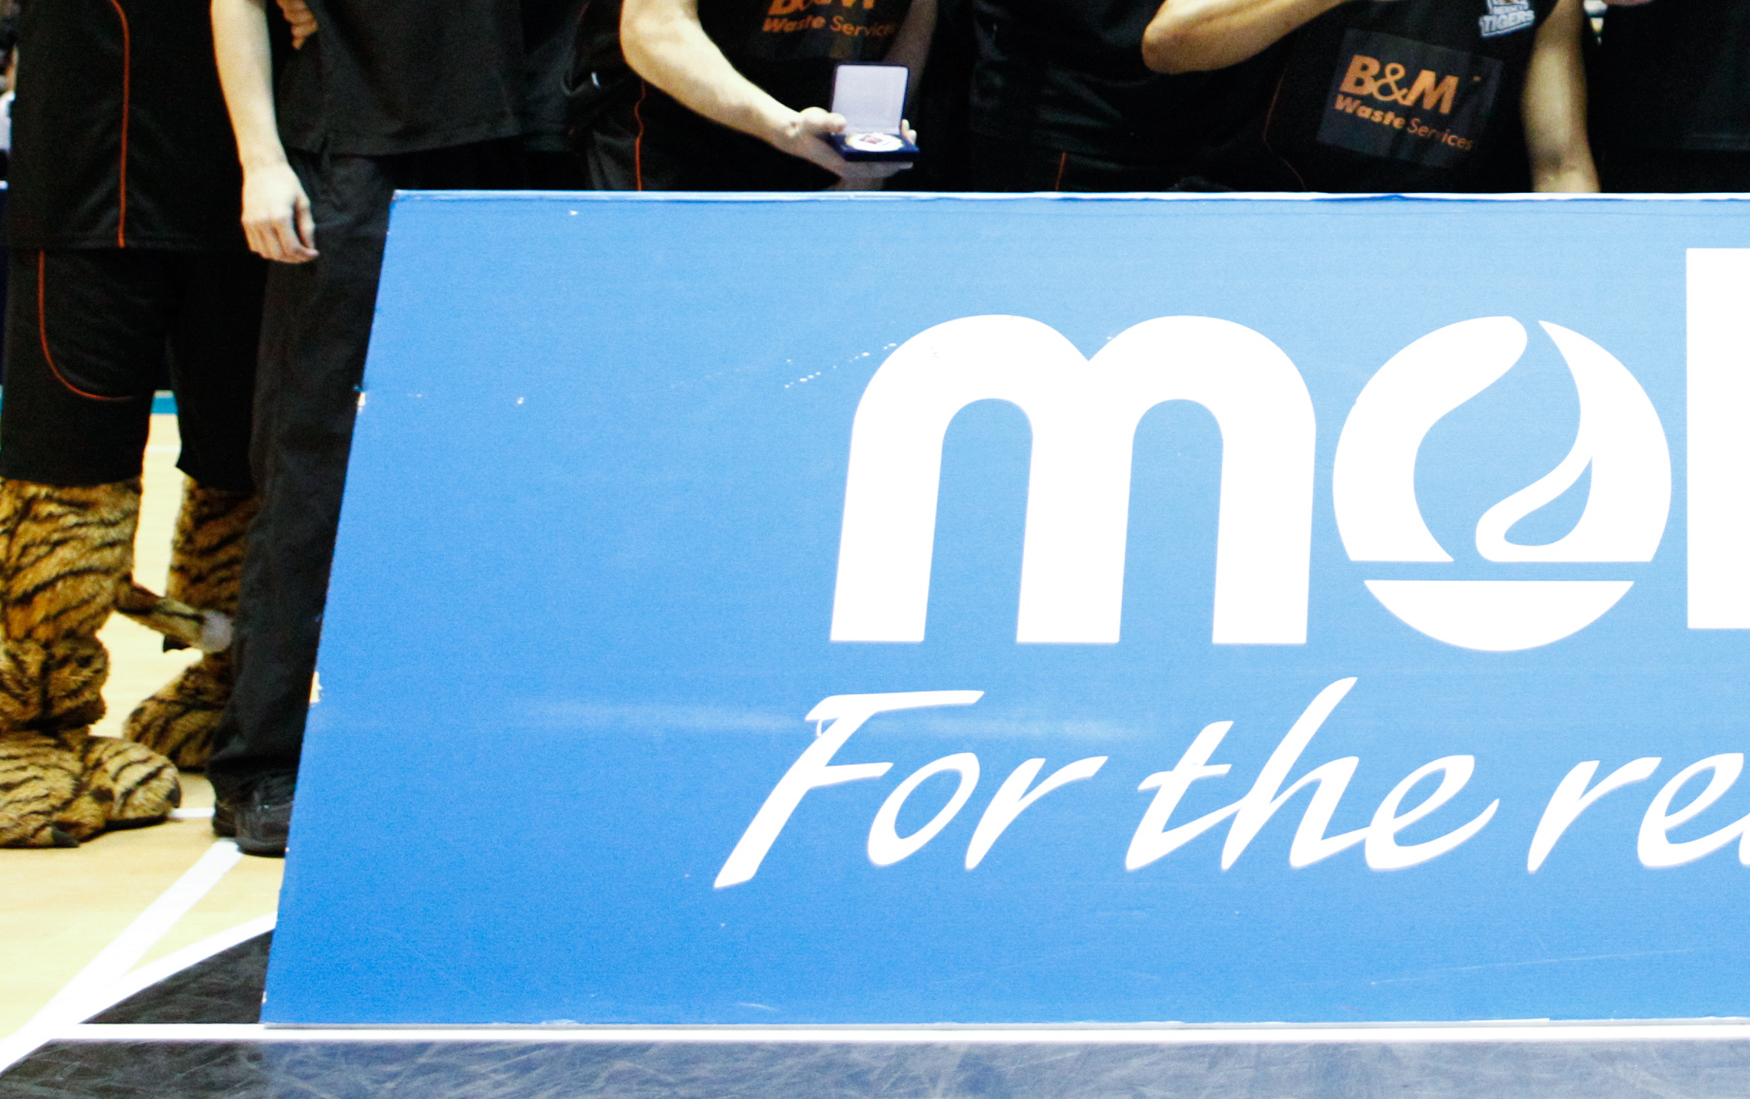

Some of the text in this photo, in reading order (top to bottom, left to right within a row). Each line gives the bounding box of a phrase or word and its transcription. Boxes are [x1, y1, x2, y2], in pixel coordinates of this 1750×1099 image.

[1481, 10, 1535, 34] TIGERS
[1338, 54, 1460, 115] B&M
[1333, 93, 1475, 151] Waste Services
[714, 690, 1109, 888] For
[1125, 676, 1500, 871] the
